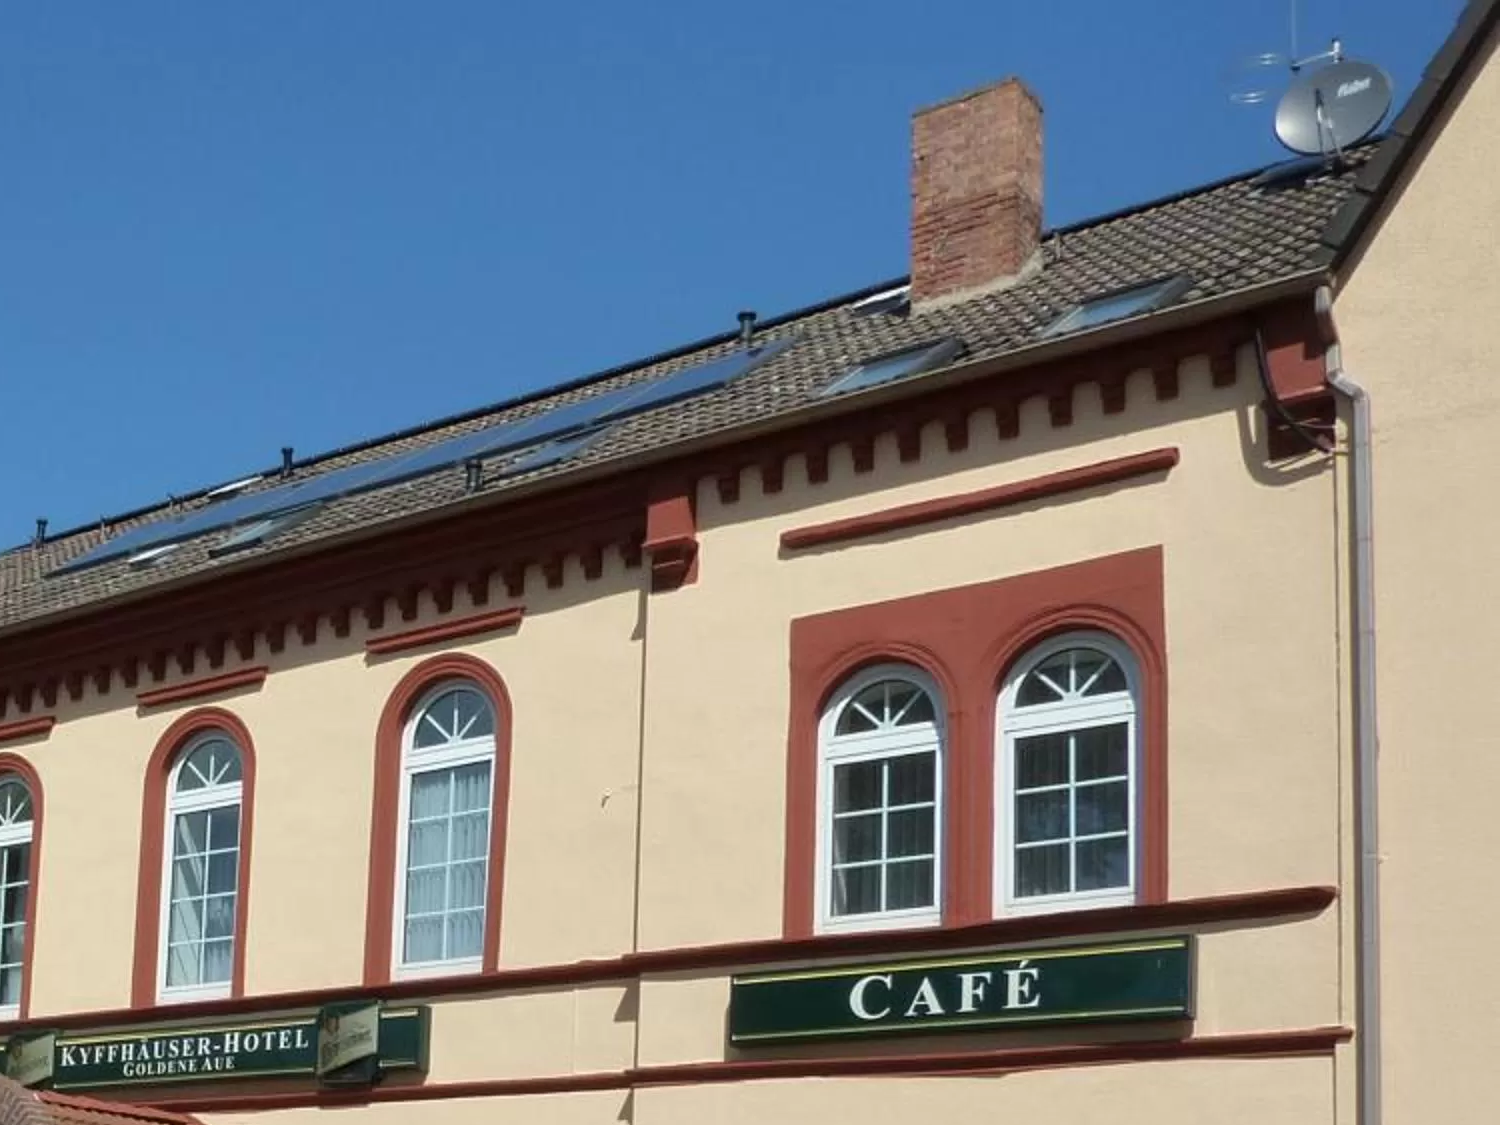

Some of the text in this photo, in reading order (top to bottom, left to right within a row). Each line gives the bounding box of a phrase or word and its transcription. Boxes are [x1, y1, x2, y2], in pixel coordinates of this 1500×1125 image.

[849, 960, 1041, 1020] CAFÉ
[60, 1029, 310, 1067] KYFFHÄUSER-HOTEL
[122, 1055, 236, 1078] GOLDENE AUE
